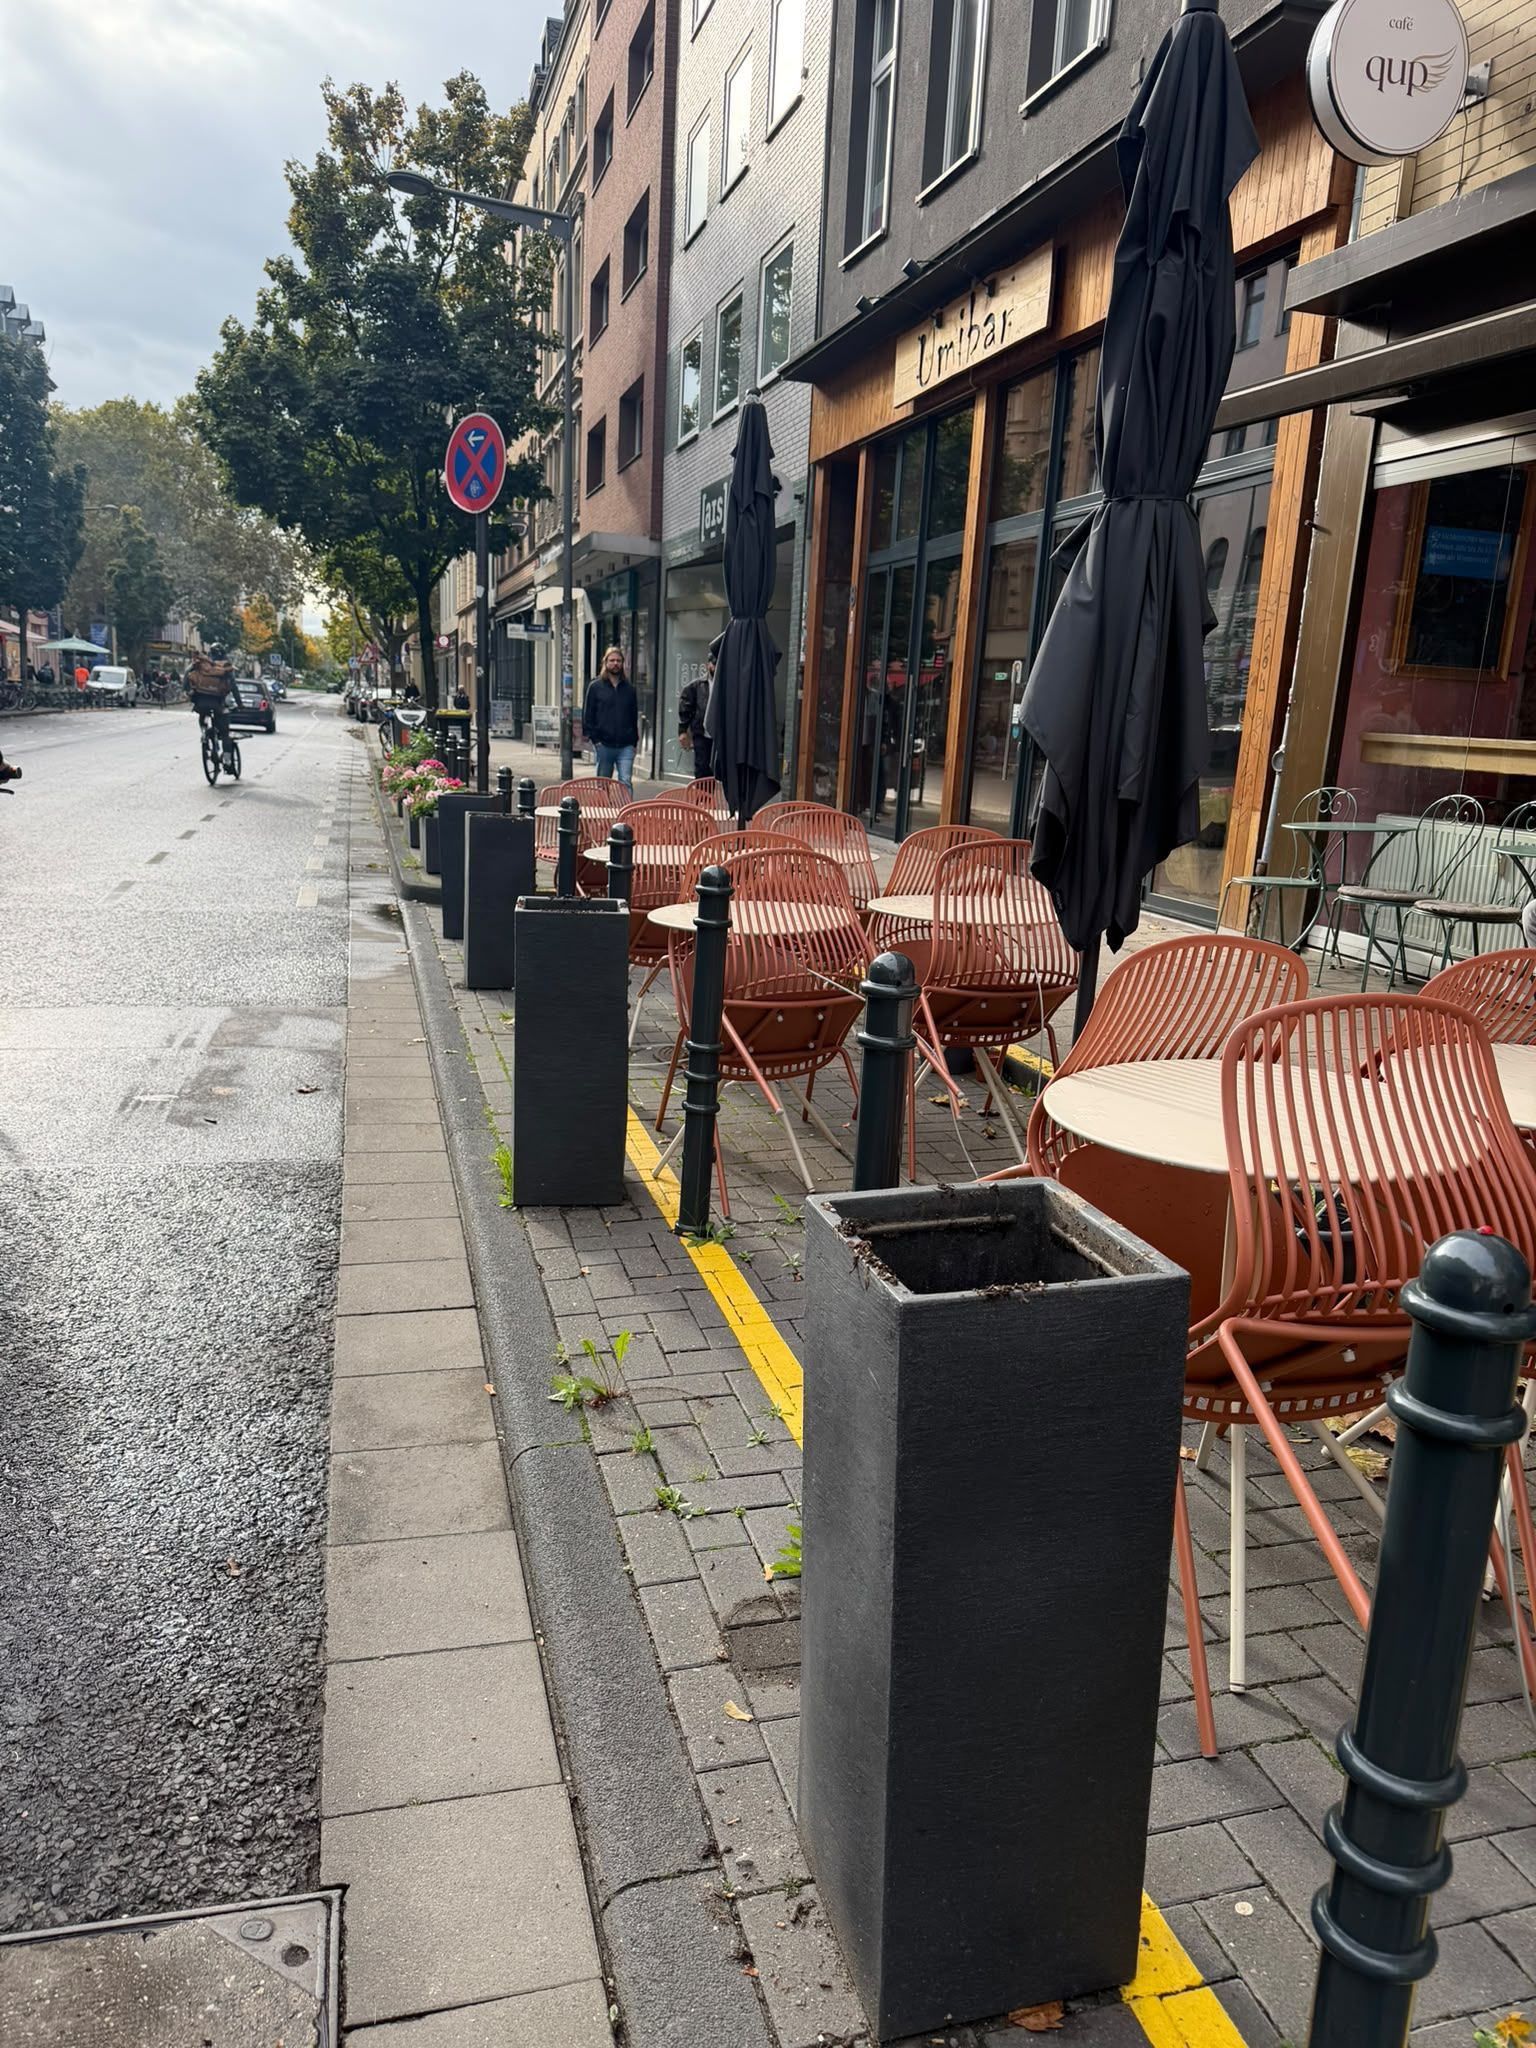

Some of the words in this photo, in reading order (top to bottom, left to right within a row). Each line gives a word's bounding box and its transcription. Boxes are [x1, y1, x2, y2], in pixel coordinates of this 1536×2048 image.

[1389, 16, 1414, 31] café
[1365, 55, 1429, 97] qup
[917, 291, 1015, 387] Umibar
